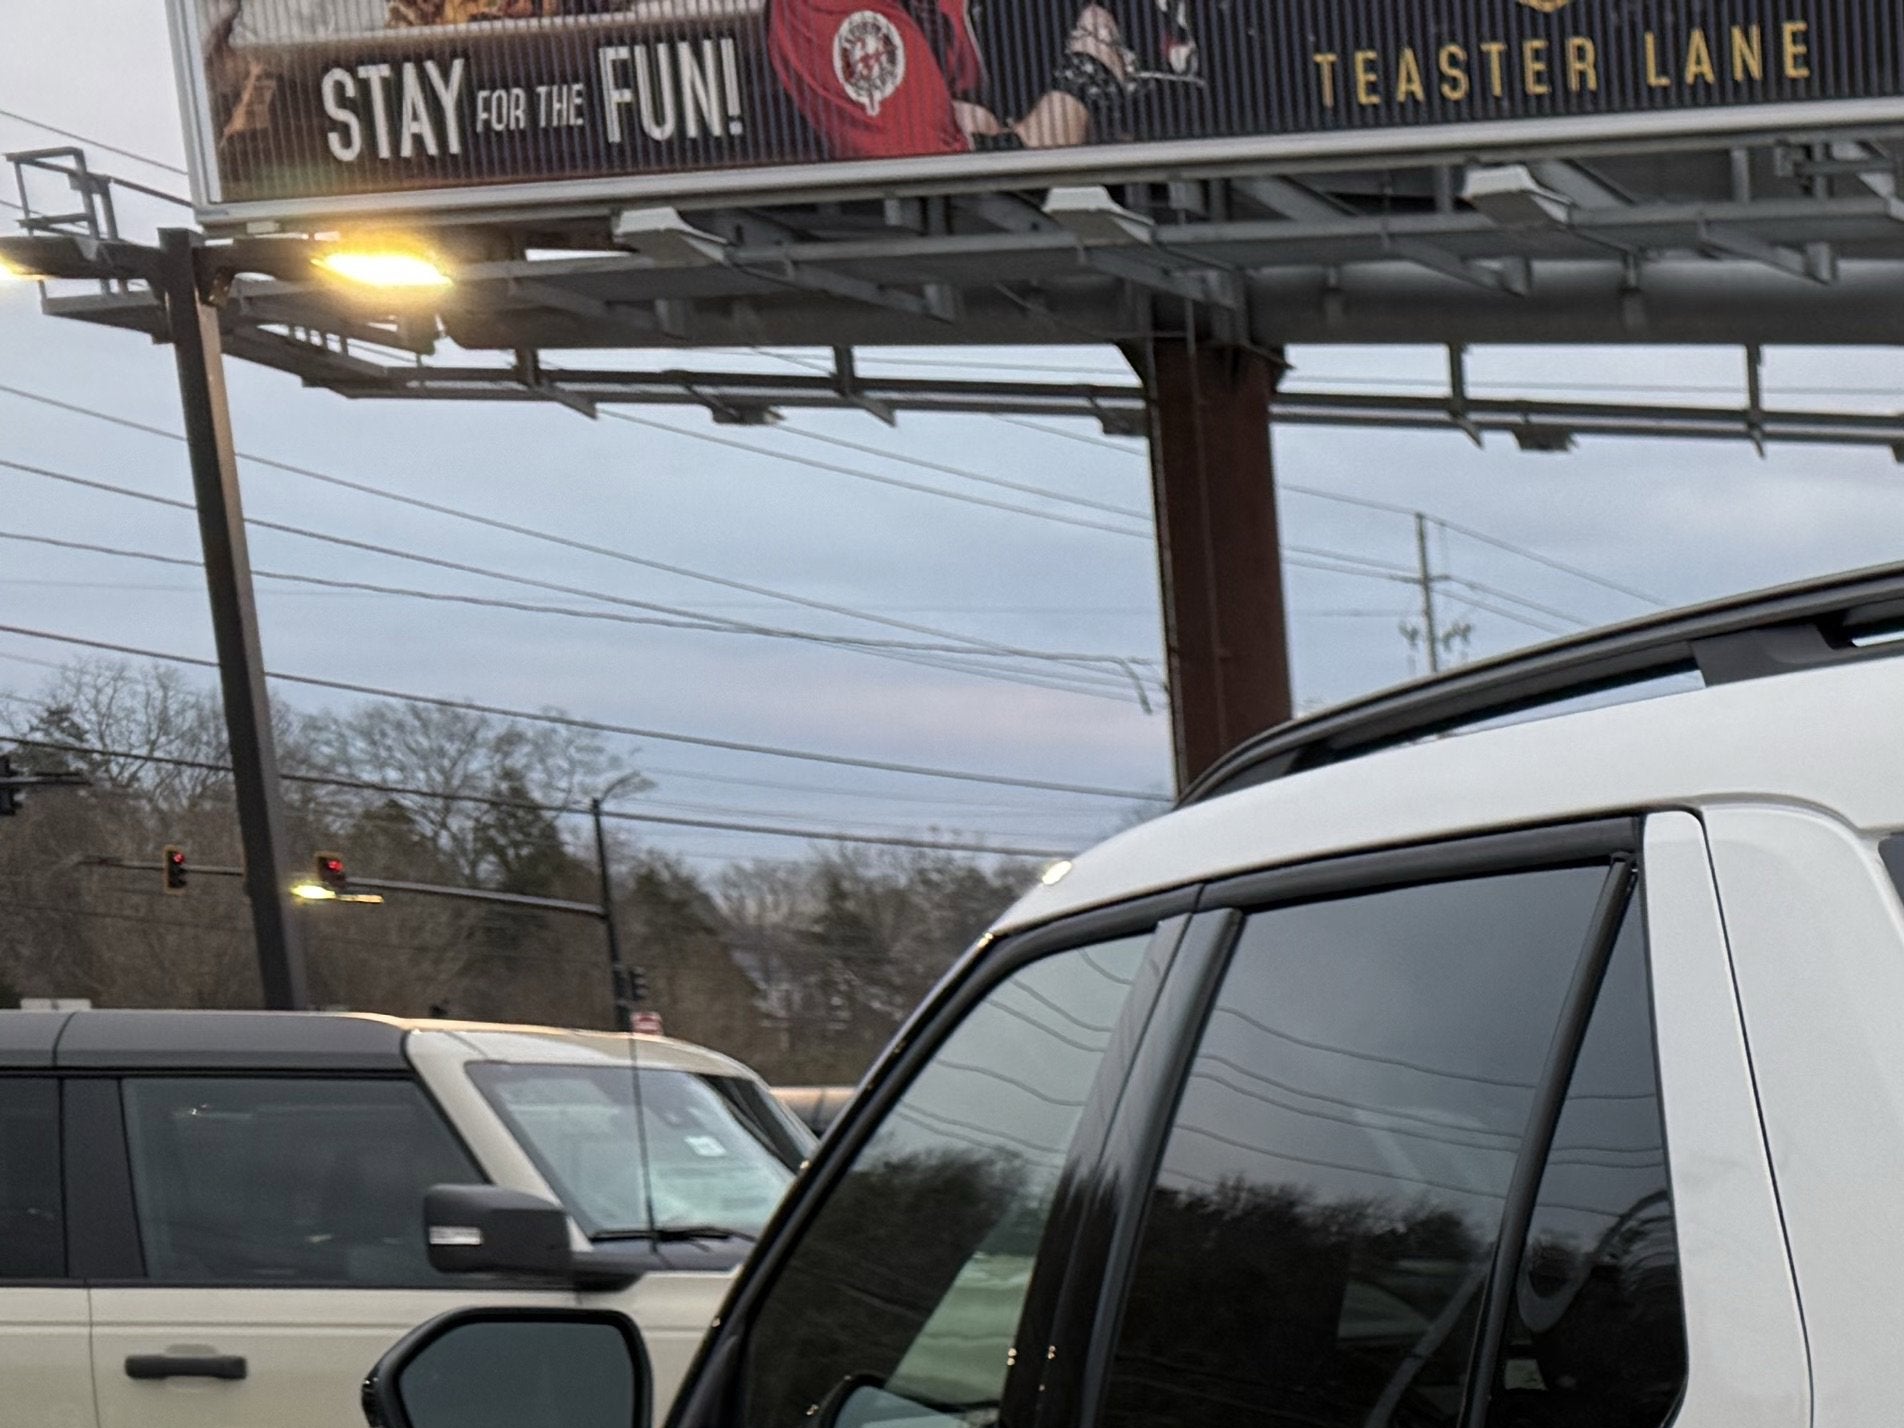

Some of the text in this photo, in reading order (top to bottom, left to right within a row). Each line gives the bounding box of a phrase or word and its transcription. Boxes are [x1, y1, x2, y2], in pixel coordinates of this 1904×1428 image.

[321, 57, 465, 162] STAY
[476, 87, 526, 134] FOR
[536, 82, 585, 129] THE
[598, 37, 743, 144] FUN!
[1312, 19, 1811, 108] TEASTER LANE
